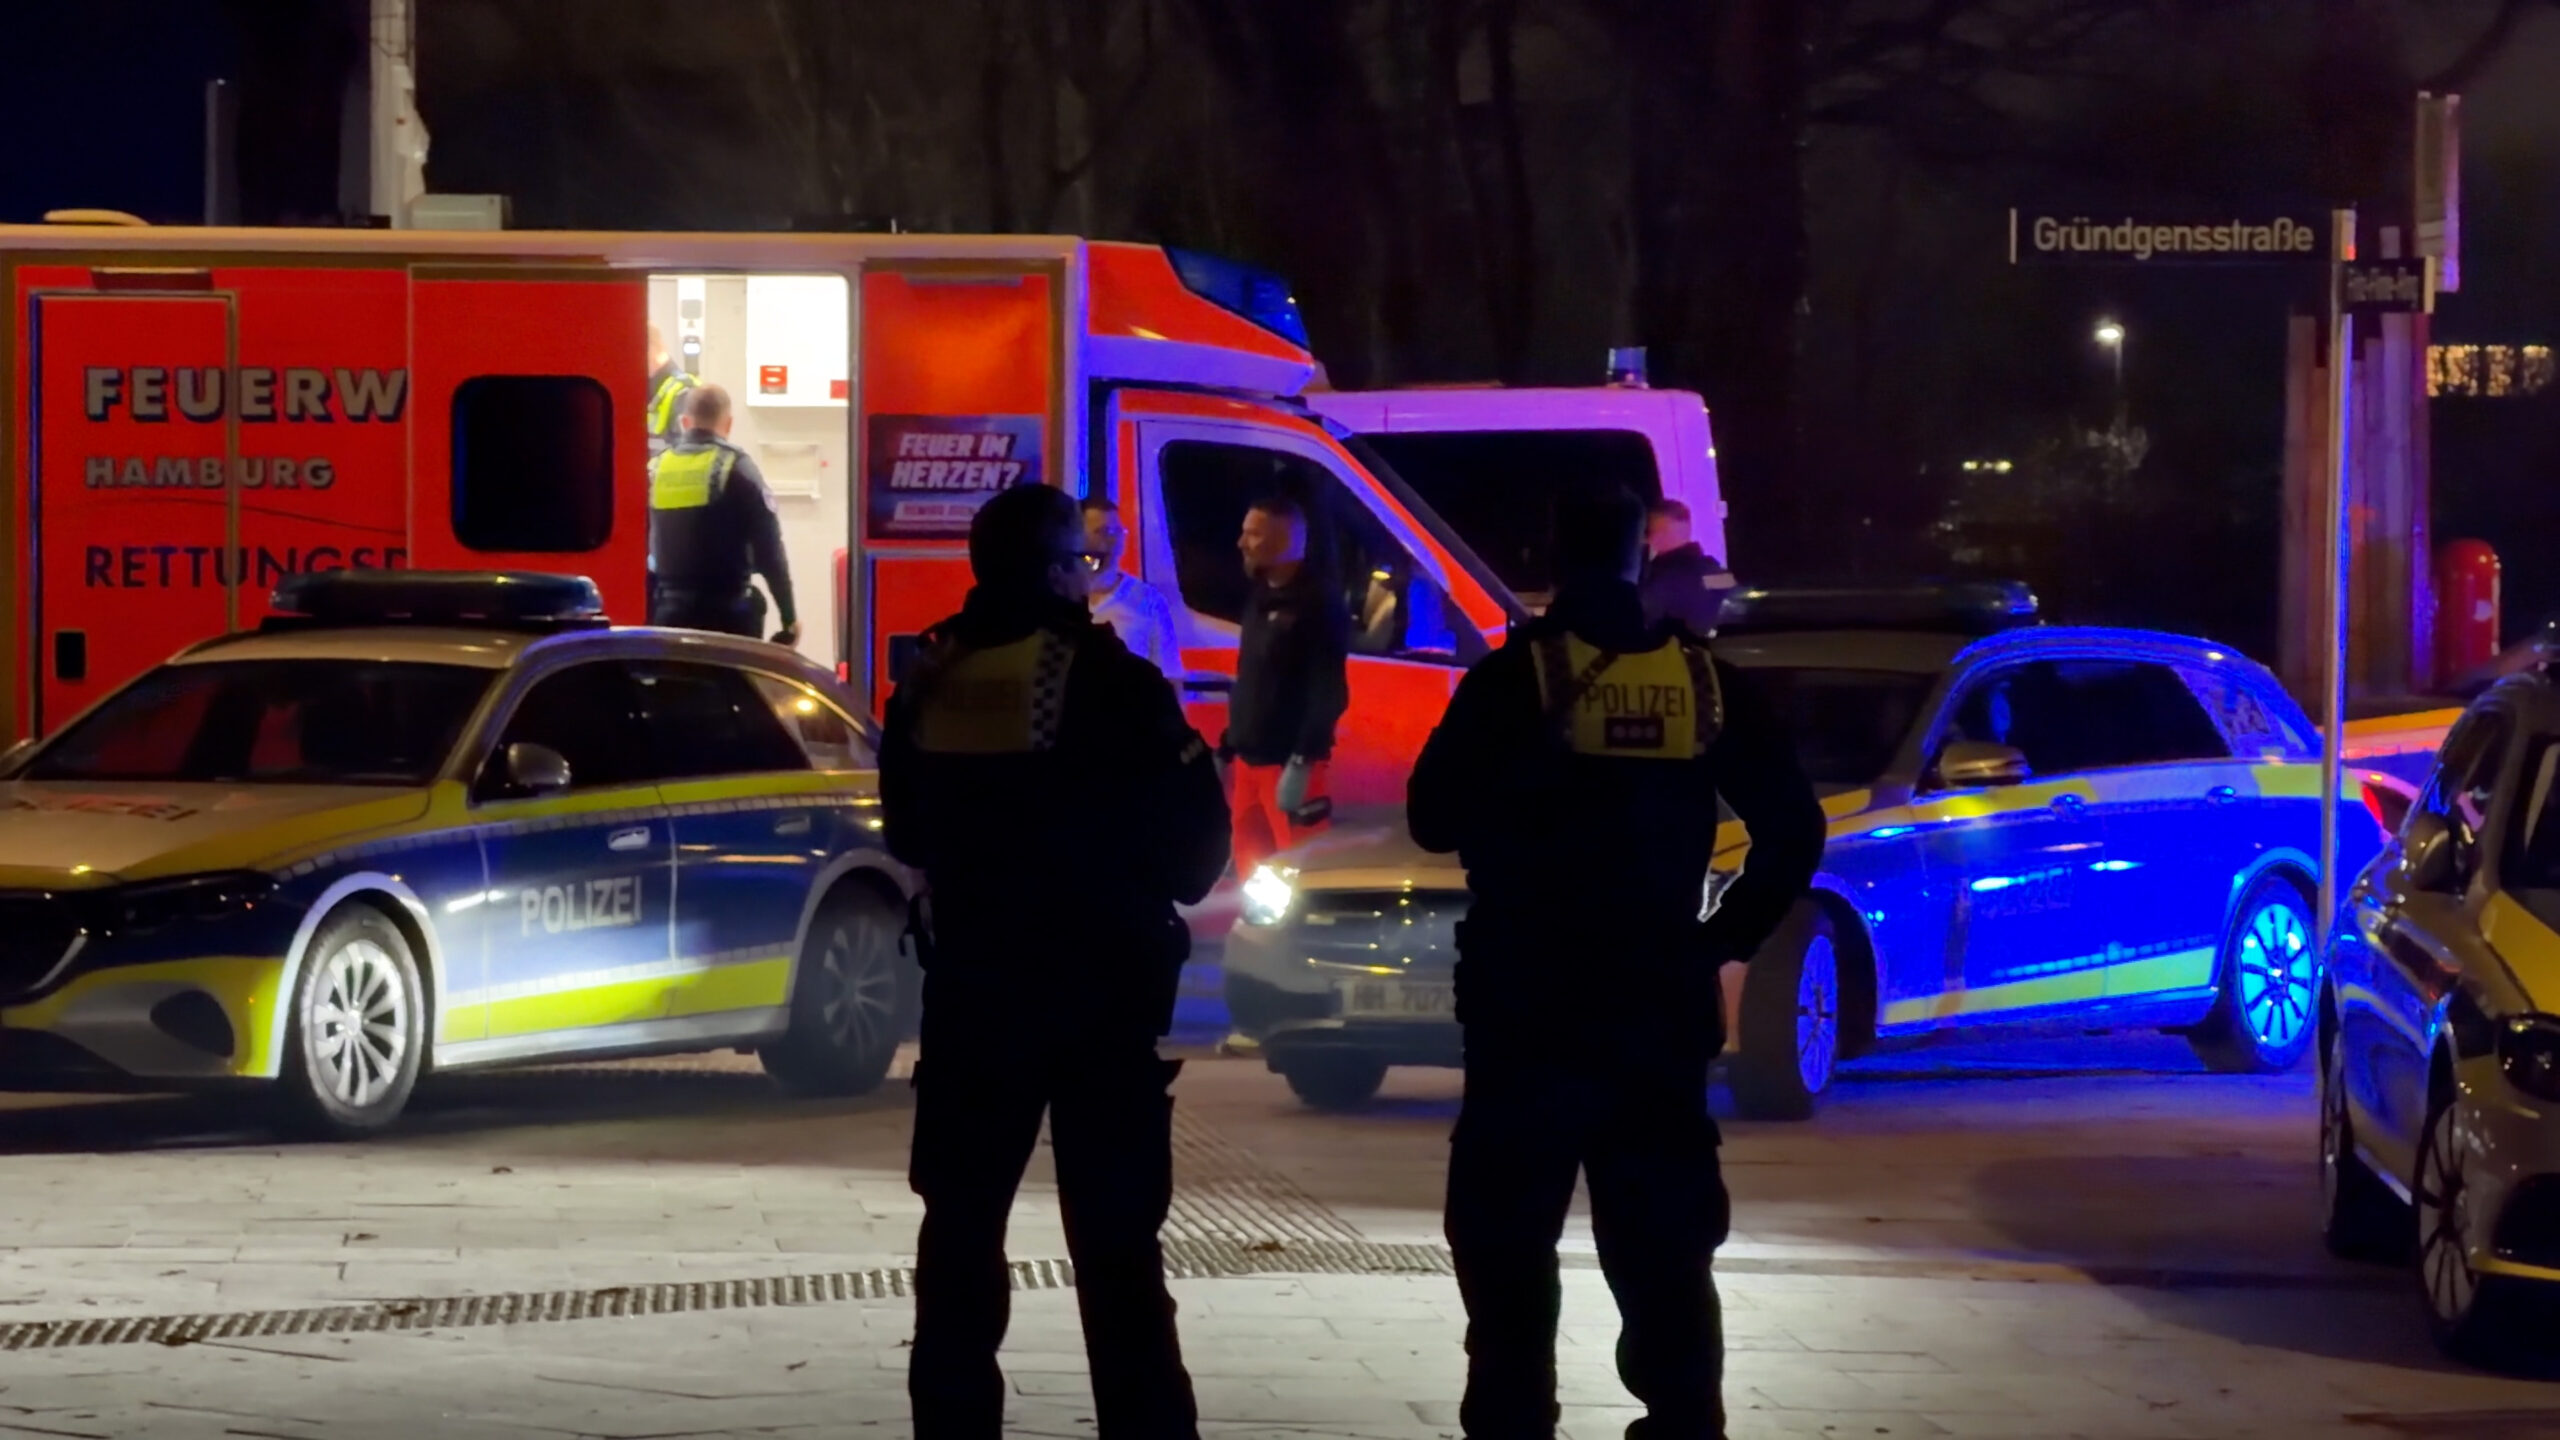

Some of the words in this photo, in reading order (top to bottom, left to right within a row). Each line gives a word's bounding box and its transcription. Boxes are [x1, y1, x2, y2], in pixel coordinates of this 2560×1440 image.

[2033, 216, 2315, 261] Gründgensstraße
[84, 366, 408, 423] FEUERW
[899, 432, 976, 458] FEUER
[978, 433, 1011, 458] IM
[85, 457, 334, 489] HAMBURG
[890, 459, 1022, 490] HERZEN?
[1583, 683, 1687, 718] POLIZEI
[520, 874, 643, 937] POLIZEI
